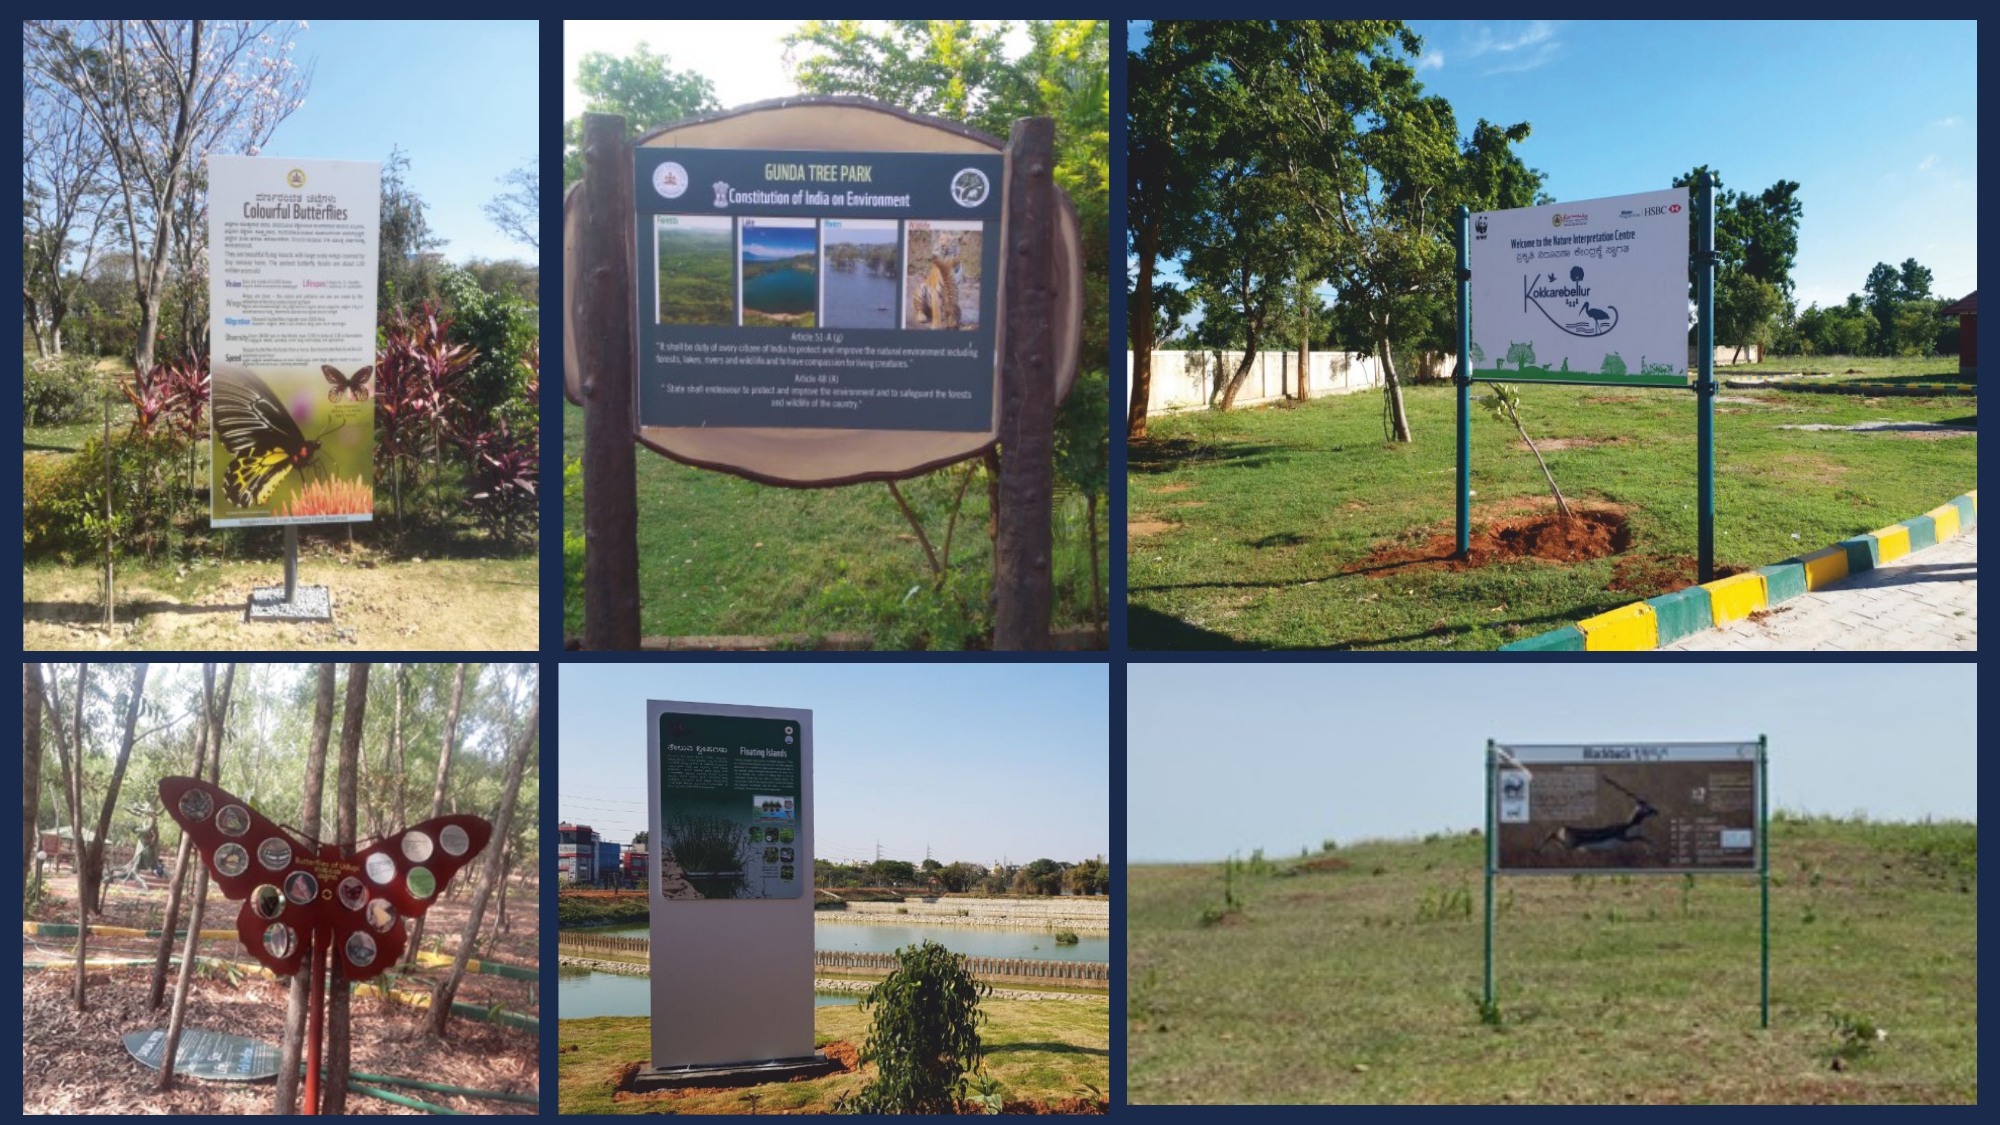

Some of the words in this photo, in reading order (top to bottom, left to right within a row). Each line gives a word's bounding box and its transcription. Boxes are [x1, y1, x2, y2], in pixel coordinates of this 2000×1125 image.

[765, 164, 805, 181] GUNDA
[810, 165, 838, 182] TREE
[840, 165, 872, 182] PARK
[729, 188, 790, 205] Constitution
[792, 190, 803, 205] of
[806, 190, 830, 206] India
[832, 194, 844, 206] on
[846, 191, 910, 207] Environment
[243, 202, 291, 219] Colourful
[294, 204, 348, 221] Butterflies
[1644, 206, 1667, 217] HSBC
[1511, 238, 1535, 249] Welcome
[1536, 238, 1542, 248] to
[1543, 236, 1552, 247] the
[1553, 235, 1572, 246] Nature
[1573, 232, 1614, 245] Interpretation
[1615, 229, 1636, 241] Centre
[1524, 273, 1591, 313] Kokkarebellur
[791, 333, 813, 341] Article
[833, 334, 844, 344] (g)
[666, 343, 683, 351] shall
[684, 343, 692, 351] be
[694, 344, 709, 353] duty
[710, 344, 718, 352] of
[719, 345, 737, 353] every
[739, 344, 761, 352] citizen
[770, 345, 787, 353] India
[797, 346, 820, 355] protect
[822, 346, 835, 354] and
[837, 347, 863, 356] improve
[864, 347, 876, 355] the
[877, 347, 901, 355] natural
[902, 348, 946, 357] environment
[225, 353, 242, 362] Speed
[705, 356, 724, 364] rivers
[725, 356, 738, 365] and
[739, 357, 765, 365] wildlife
[766, 357, 779, 366] and
[786, 358, 804, 366] have
[805, 358, 846, 368] compassion
[846, 358, 855, 367] for
[856, 359, 874, 370] living
[795, 374, 816, 383] Article
[667, 384, 685, 393] State
[687, 385, 704, 393] shall
[705, 385, 742, 394] endeavour
[742, 386, 750, 394] to
[752, 386, 775, 396] protect
[777, 387, 790, 396] and
[791, 387, 818, 396] improve
[820, 388, 832, 396] the
[833, 388, 875, 397] environment
[876, 389, 889, 397] and
[891, 389, 898, 397] to
[900, 389, 934, 399] safeguard
[936, 390, 946, 398] the
[948, 390, 972, 399] forests
[771, 398, 785, 407] and
[785, 399, 810, 408] wildlife
[811, 399, 818, 408] of
[820, 400, 832, 408] the
[740, 747, 765, 758] Floating
[766, 748, 788, 758] Islands
